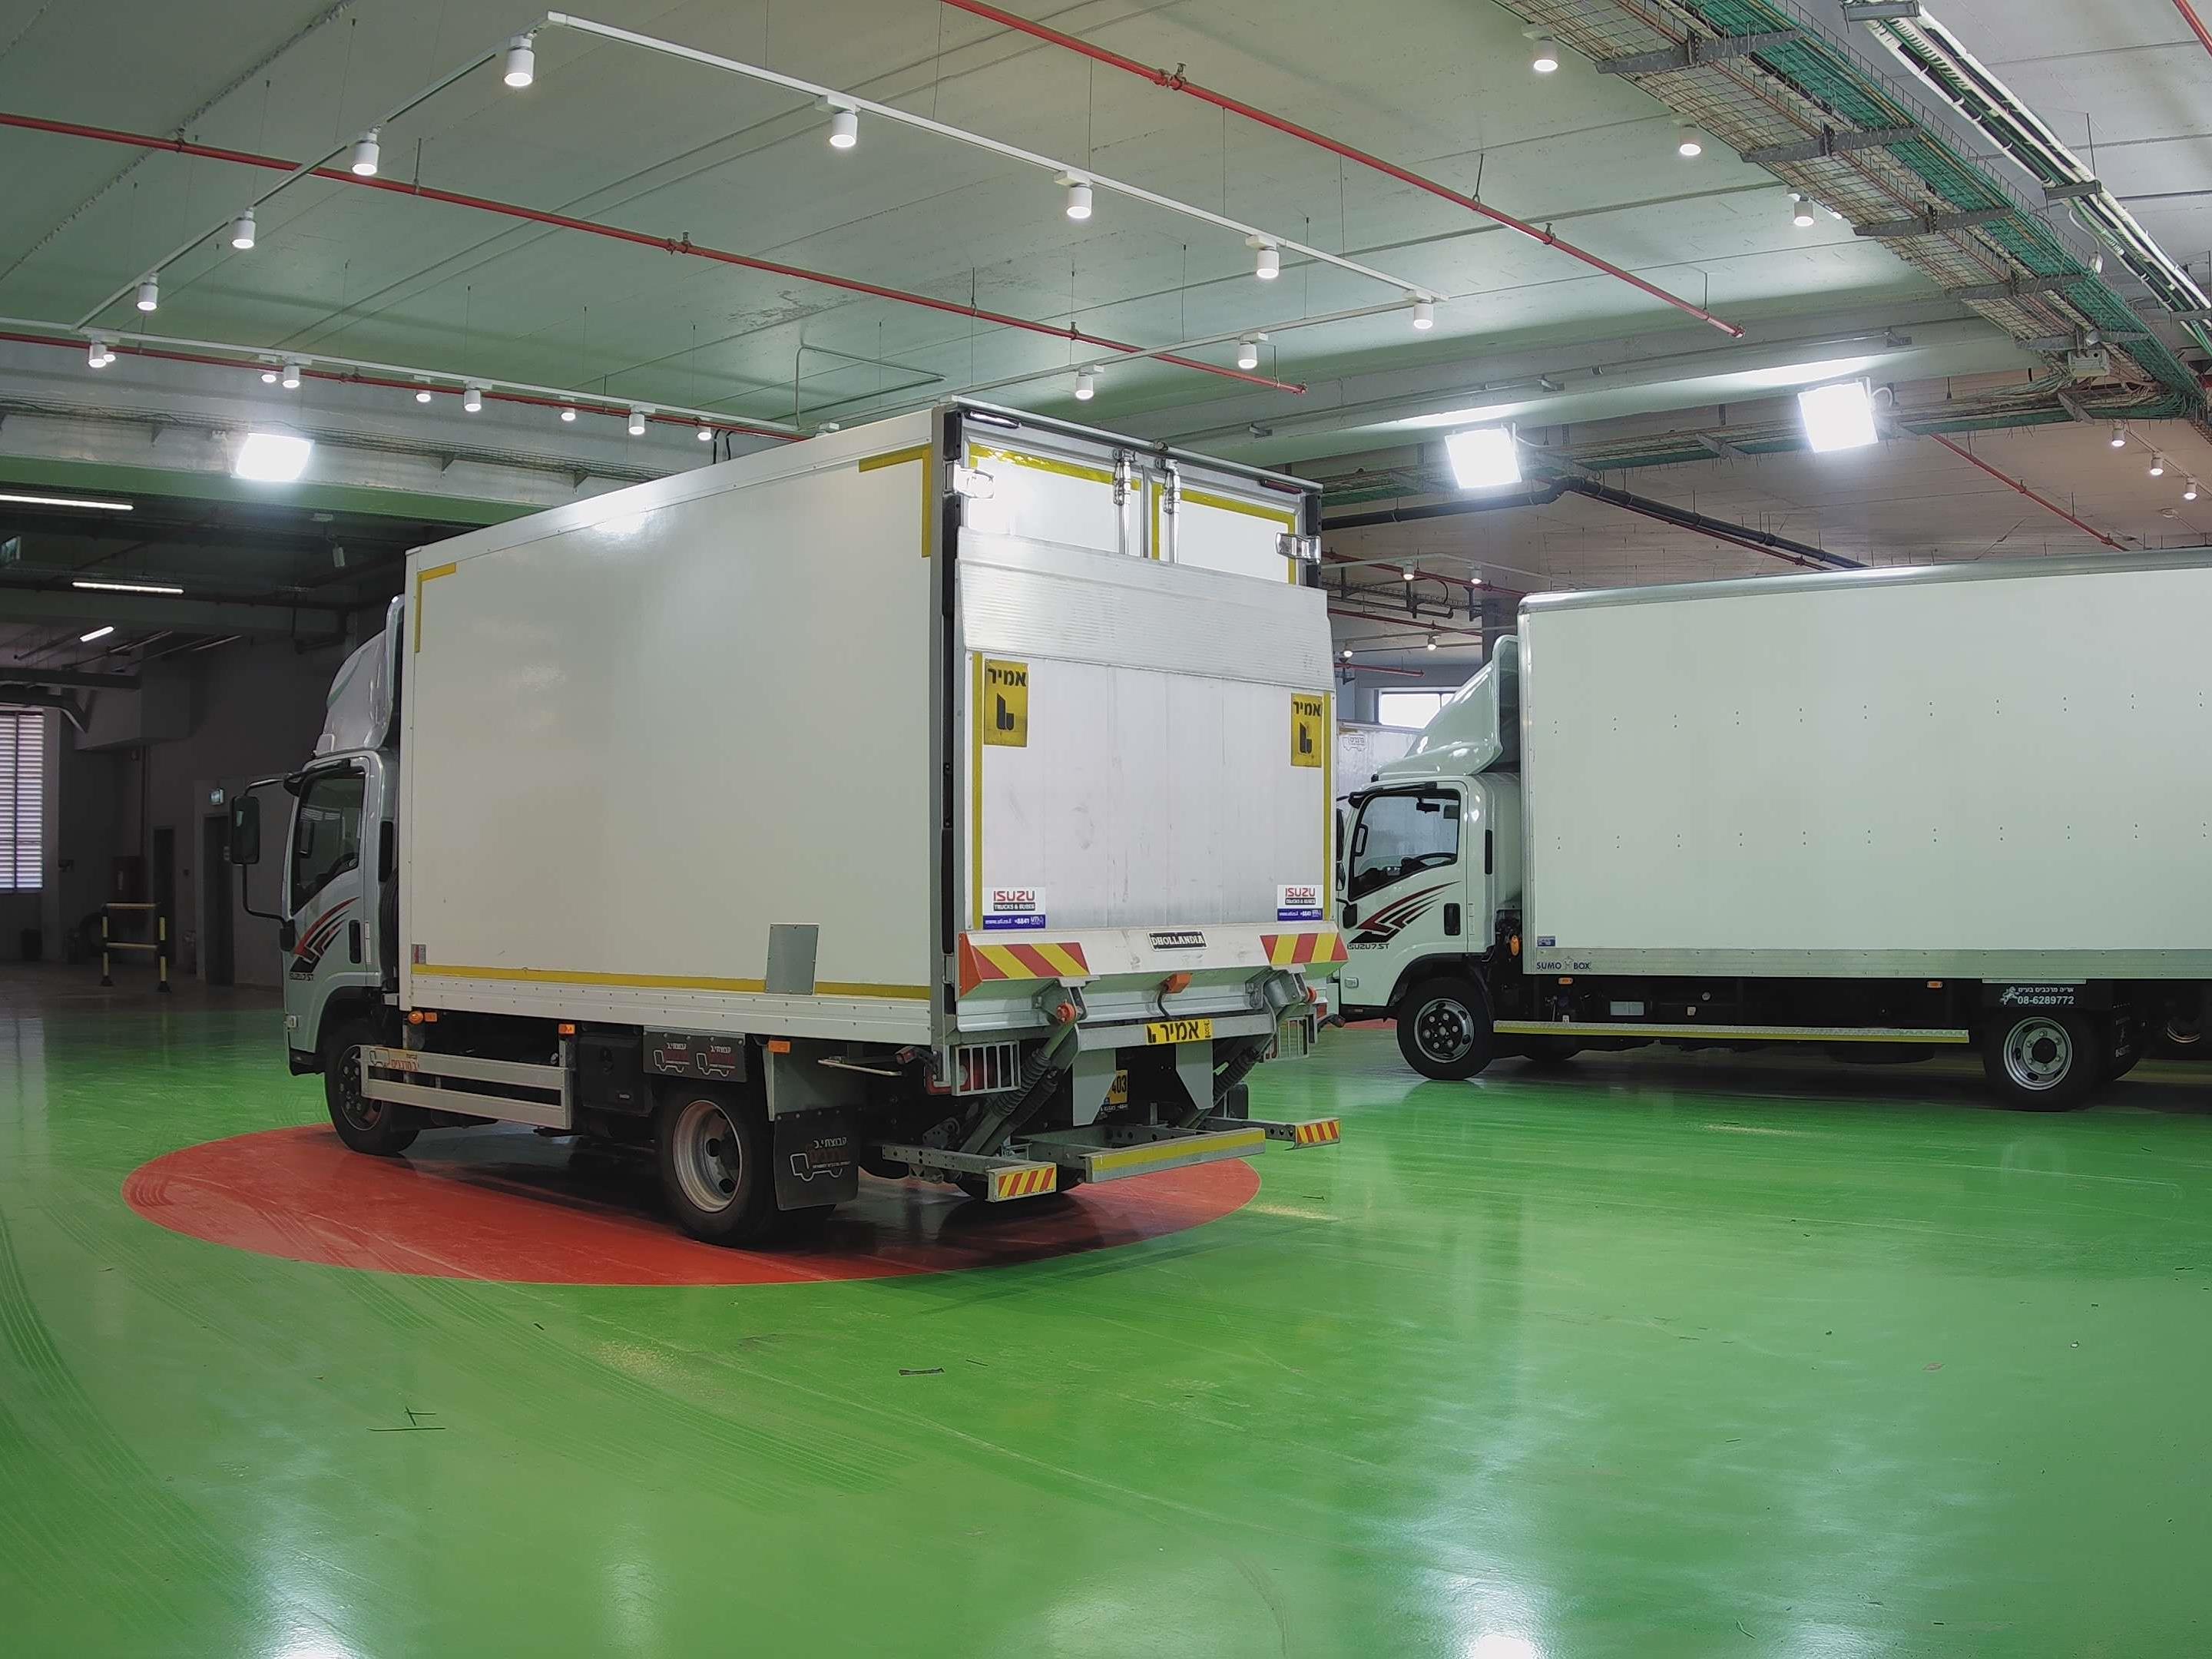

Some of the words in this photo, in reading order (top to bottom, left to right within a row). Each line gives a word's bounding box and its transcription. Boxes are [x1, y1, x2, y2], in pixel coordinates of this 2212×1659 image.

[988, 668, 1026, 687] אמיר
[1293, 701, 1321, 716] אמיר
[993, 890, 1035, 902] ISUZU
[1285, 887, 1316, 897] ISUZU
[1151, 935, 1205, 945] DHOLLANDIA
[1536, 962, 1562, 970] SUMO
[1573, 962, 1591, 970] BOX
[2017, 995, 2075, 1005] 08-6289772
[1160, 1021, 1200, 1041] אמיר
[1111, 1075, 1127, 1094] 403
